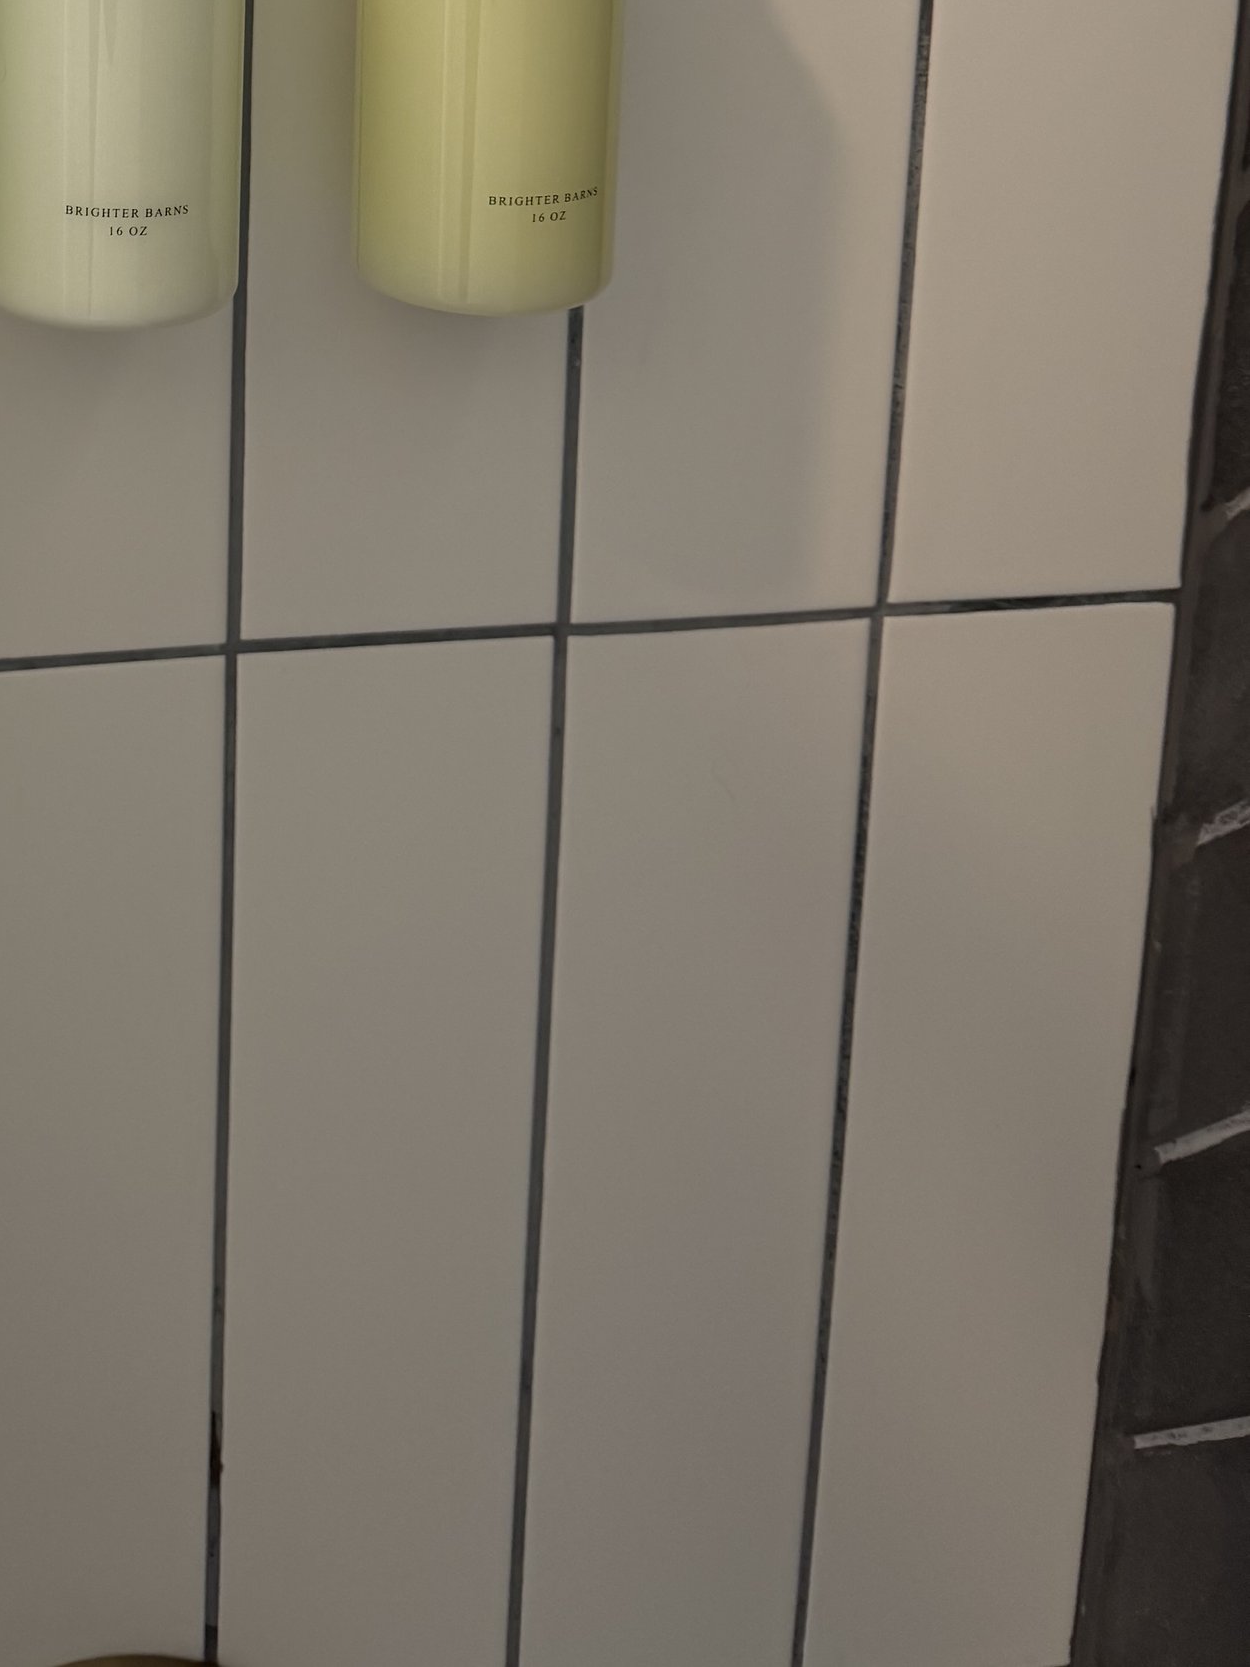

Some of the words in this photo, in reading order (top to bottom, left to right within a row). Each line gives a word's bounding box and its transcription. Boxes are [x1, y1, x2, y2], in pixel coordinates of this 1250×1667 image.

[488, 194, 561, 207] BRIGHTER
[564, 186, 599, 203] BARNS
[65, 205, 140, 219] BRIGHTER
[144, 204, 190, 218] BARNS
[532, 212, 546, 223] 16
[549, 210, 567, 222] OZ
[109, 225, 124, 237] 16
[128, 225, 148, 237] OZ
